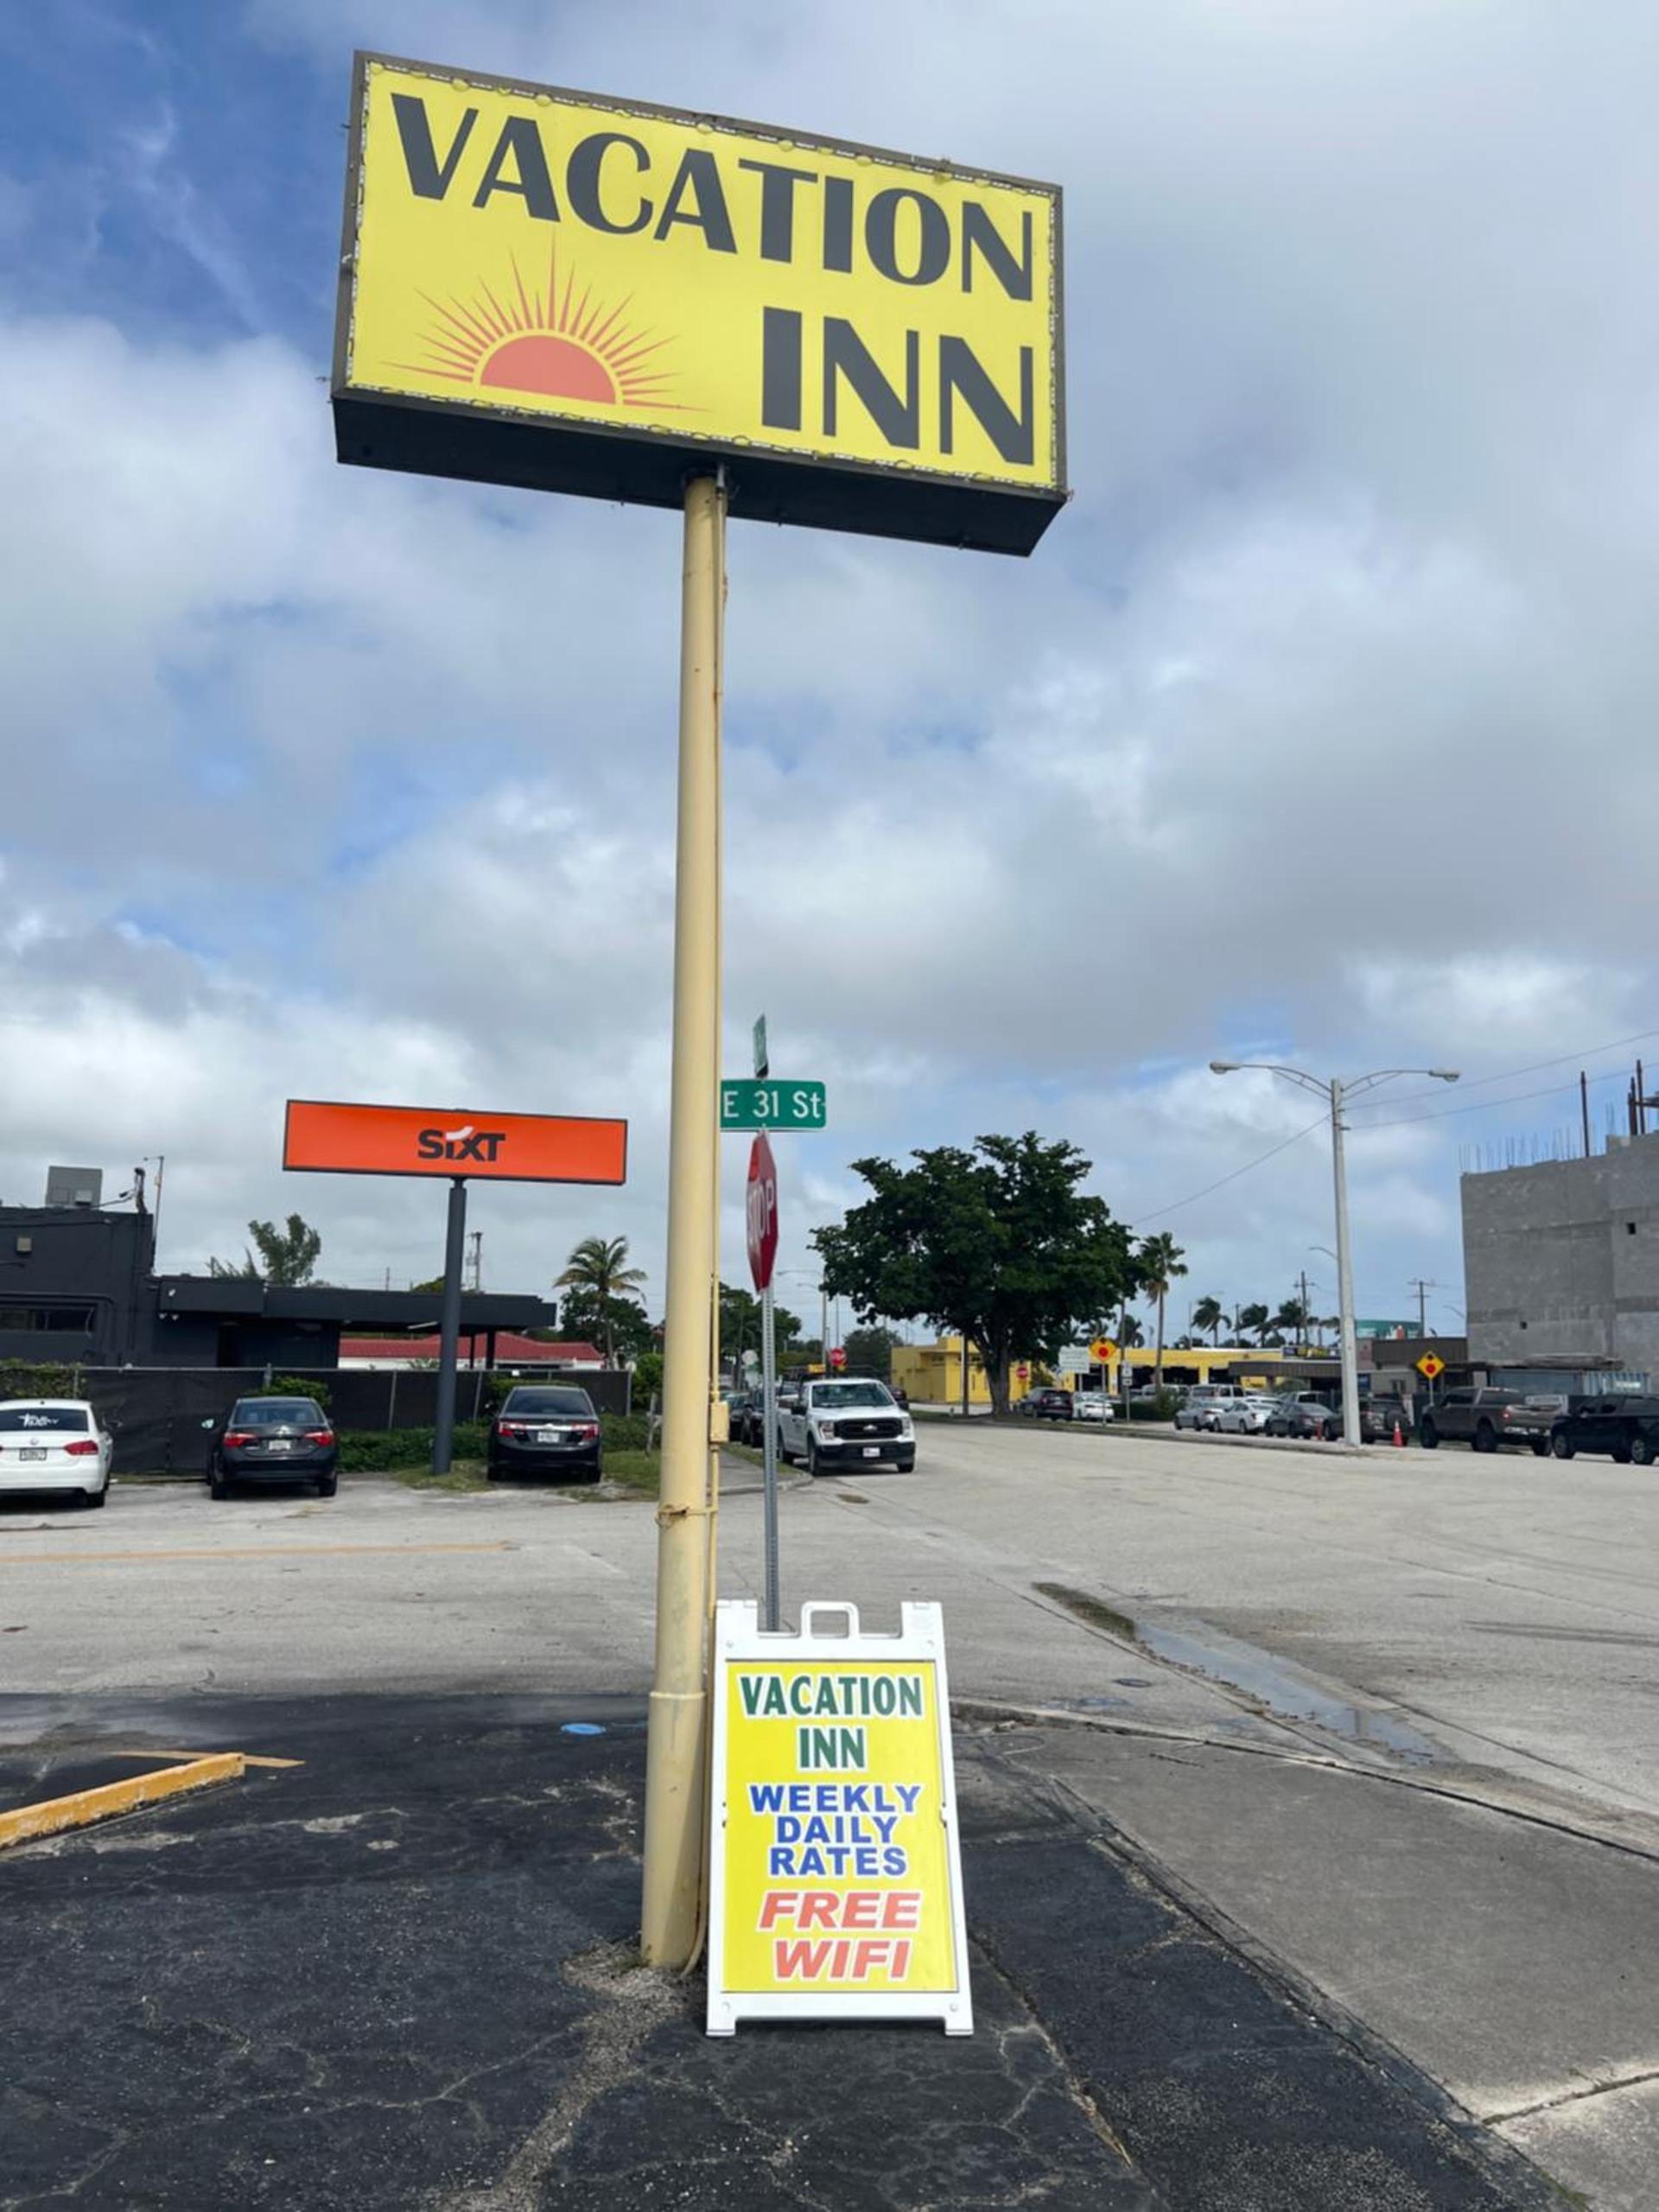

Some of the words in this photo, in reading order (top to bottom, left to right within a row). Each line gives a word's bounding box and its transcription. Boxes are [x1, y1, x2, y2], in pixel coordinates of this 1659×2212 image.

[391, 92, 1033, 302] VACATION
[762, 306, 1034, 466] INN
[723, 1090, 738, 1118] E
[753, 1090, 779, 1118] 31
[792, 1090, 822, 1119] St
[741, 1675, 922, 1716] VACATION
[799, 1728, 865, 1769] INN
[750, 1784, 922, 1812] WEEKLY
[777, 1815, 898, 1844] DAILY
[770, 1847, 906, 1876] RATES
[759, 1891, 920, 1929] FREE
[776, 1941, 911, 1979] WIFI
